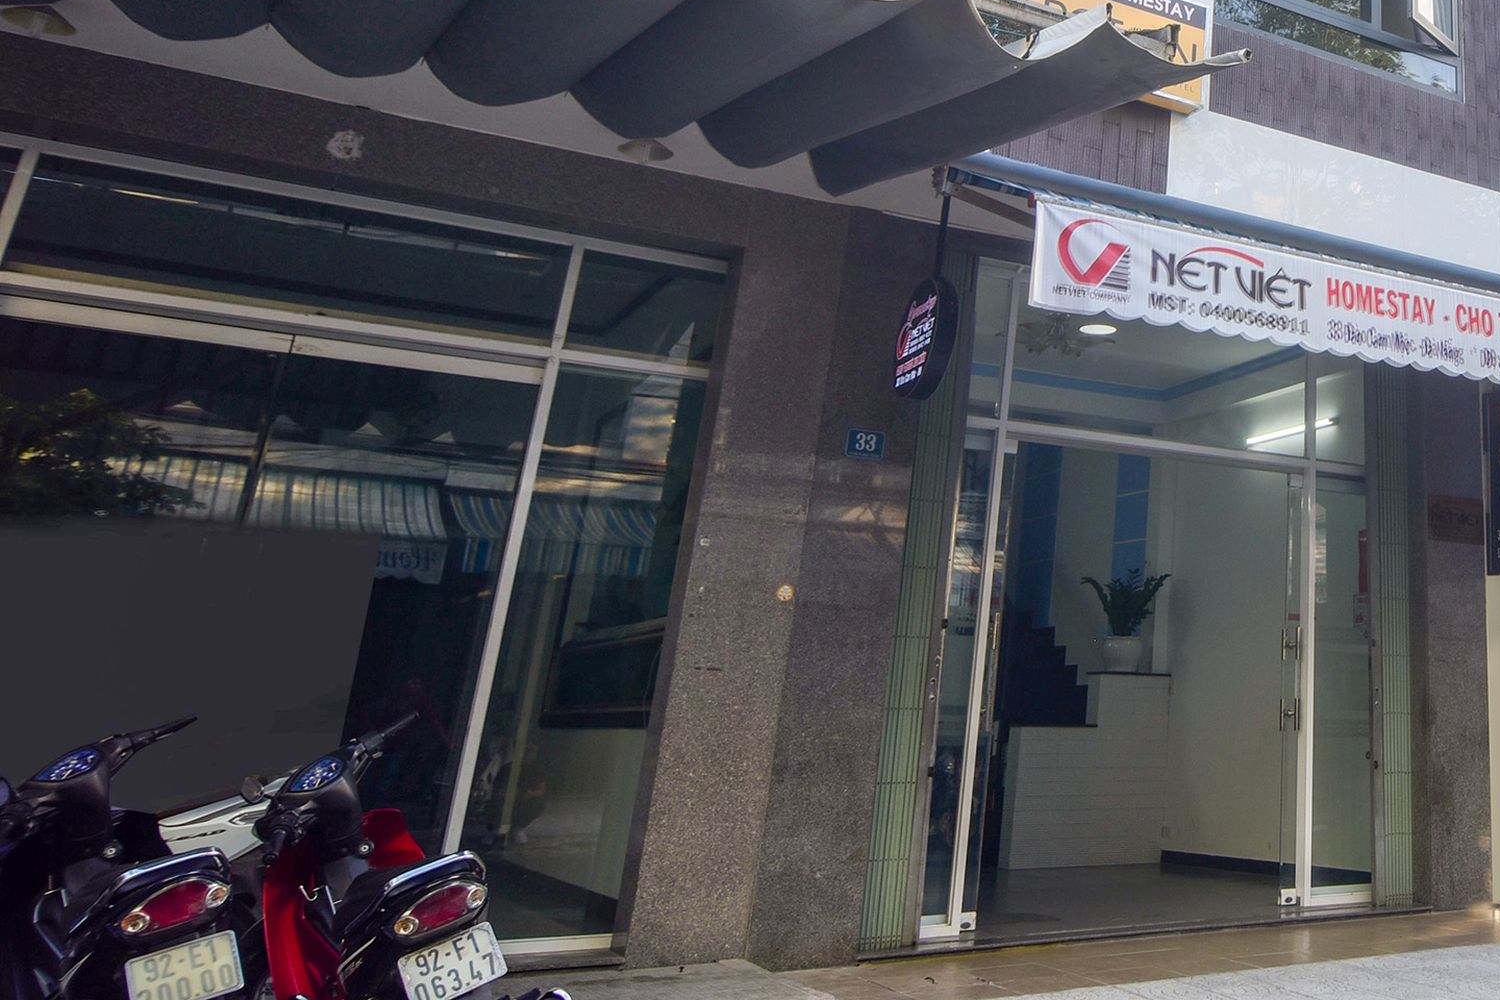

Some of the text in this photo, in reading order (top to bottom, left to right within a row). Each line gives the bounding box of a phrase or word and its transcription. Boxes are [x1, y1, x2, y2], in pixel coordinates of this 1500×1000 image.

[1151, 248, 1228, 295] NET
[1326, 277, 1435, 327] HOMESTAY
[1455, 303, 1494, 338] CHO
[855, 432, 877, 452] 33
[143, 940, 218, 983] 92-E1
[413, 952, 497, 1000] 063.47
[414, 932, 481, 977] 92-F1
